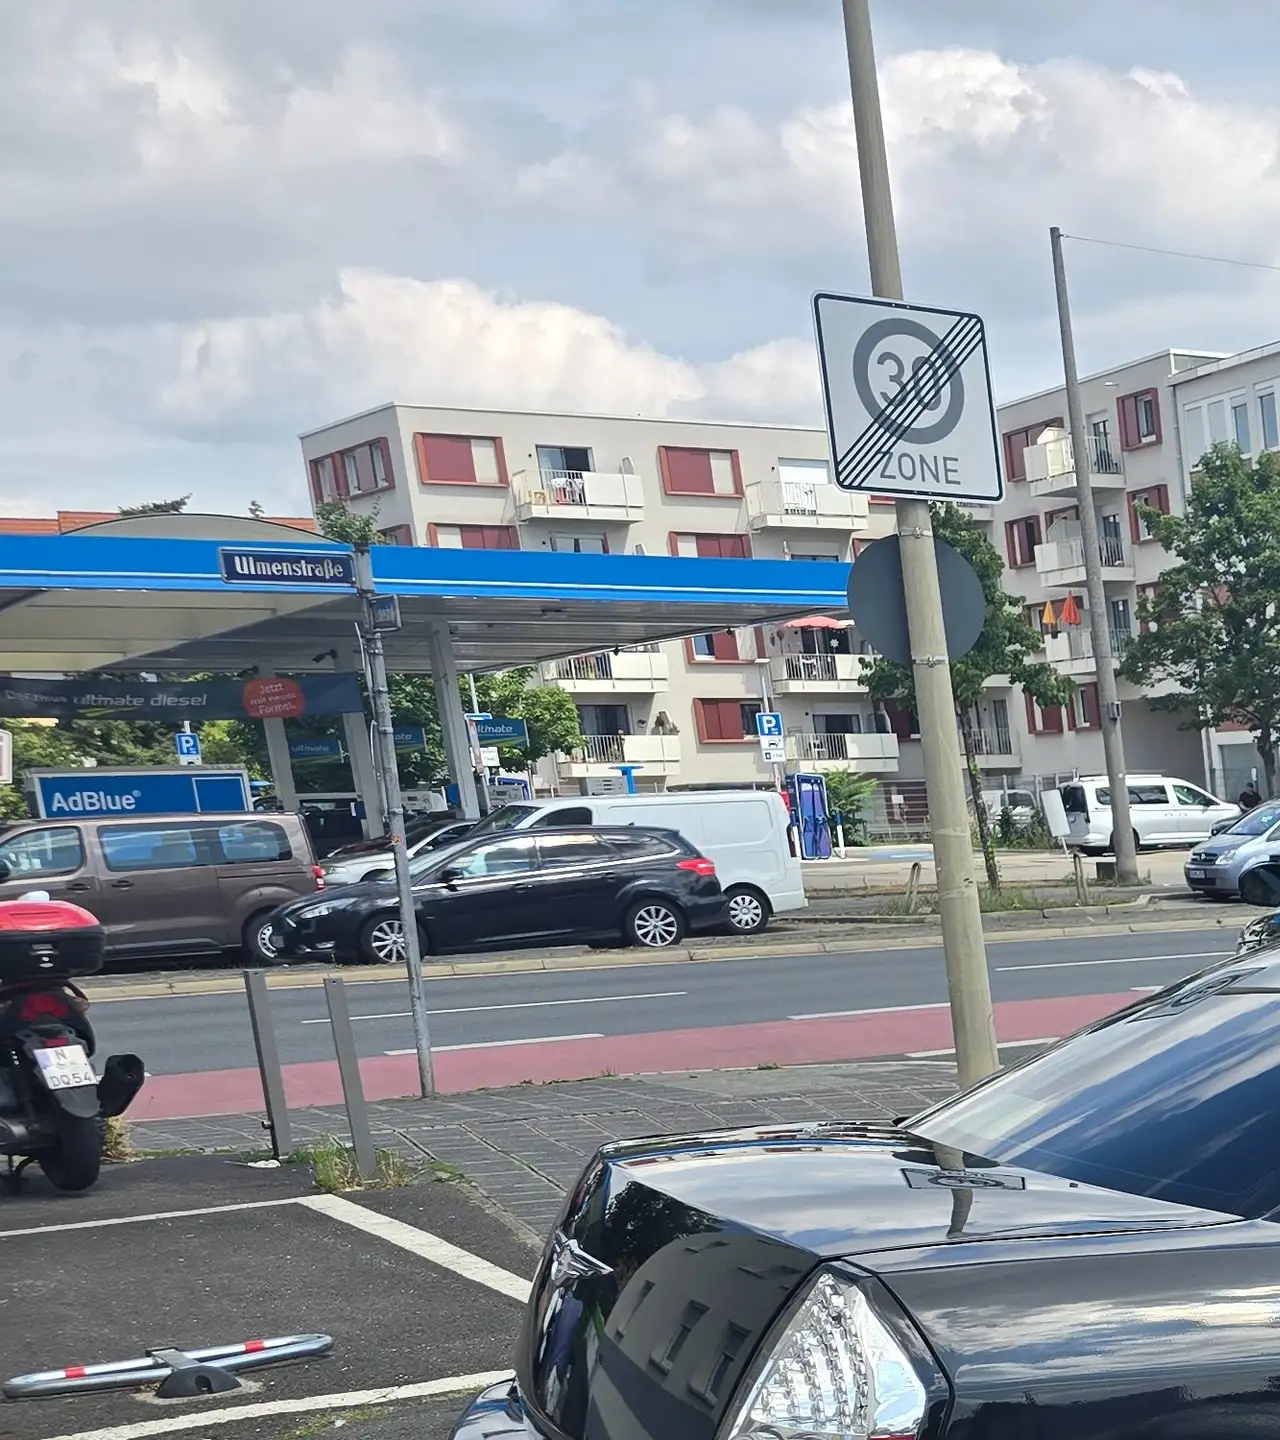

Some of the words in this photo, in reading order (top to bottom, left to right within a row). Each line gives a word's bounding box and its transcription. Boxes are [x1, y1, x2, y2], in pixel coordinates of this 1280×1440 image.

[877, 352, 941, 411] 30
[878, 451, 961, 485] ZONE
[234, 555, 344, 579] Ulmenstraße
[260, 683, 284, 694] Jetzt
[74, 694, 144, 706] ultimate
[150, 694, 206, 706] diesel
[477, 723, 513, 733] ltimate
[761, 715, 776, 734] P
[181, 736, 194, 753] P
[54, 1049, 67, 1060] N
